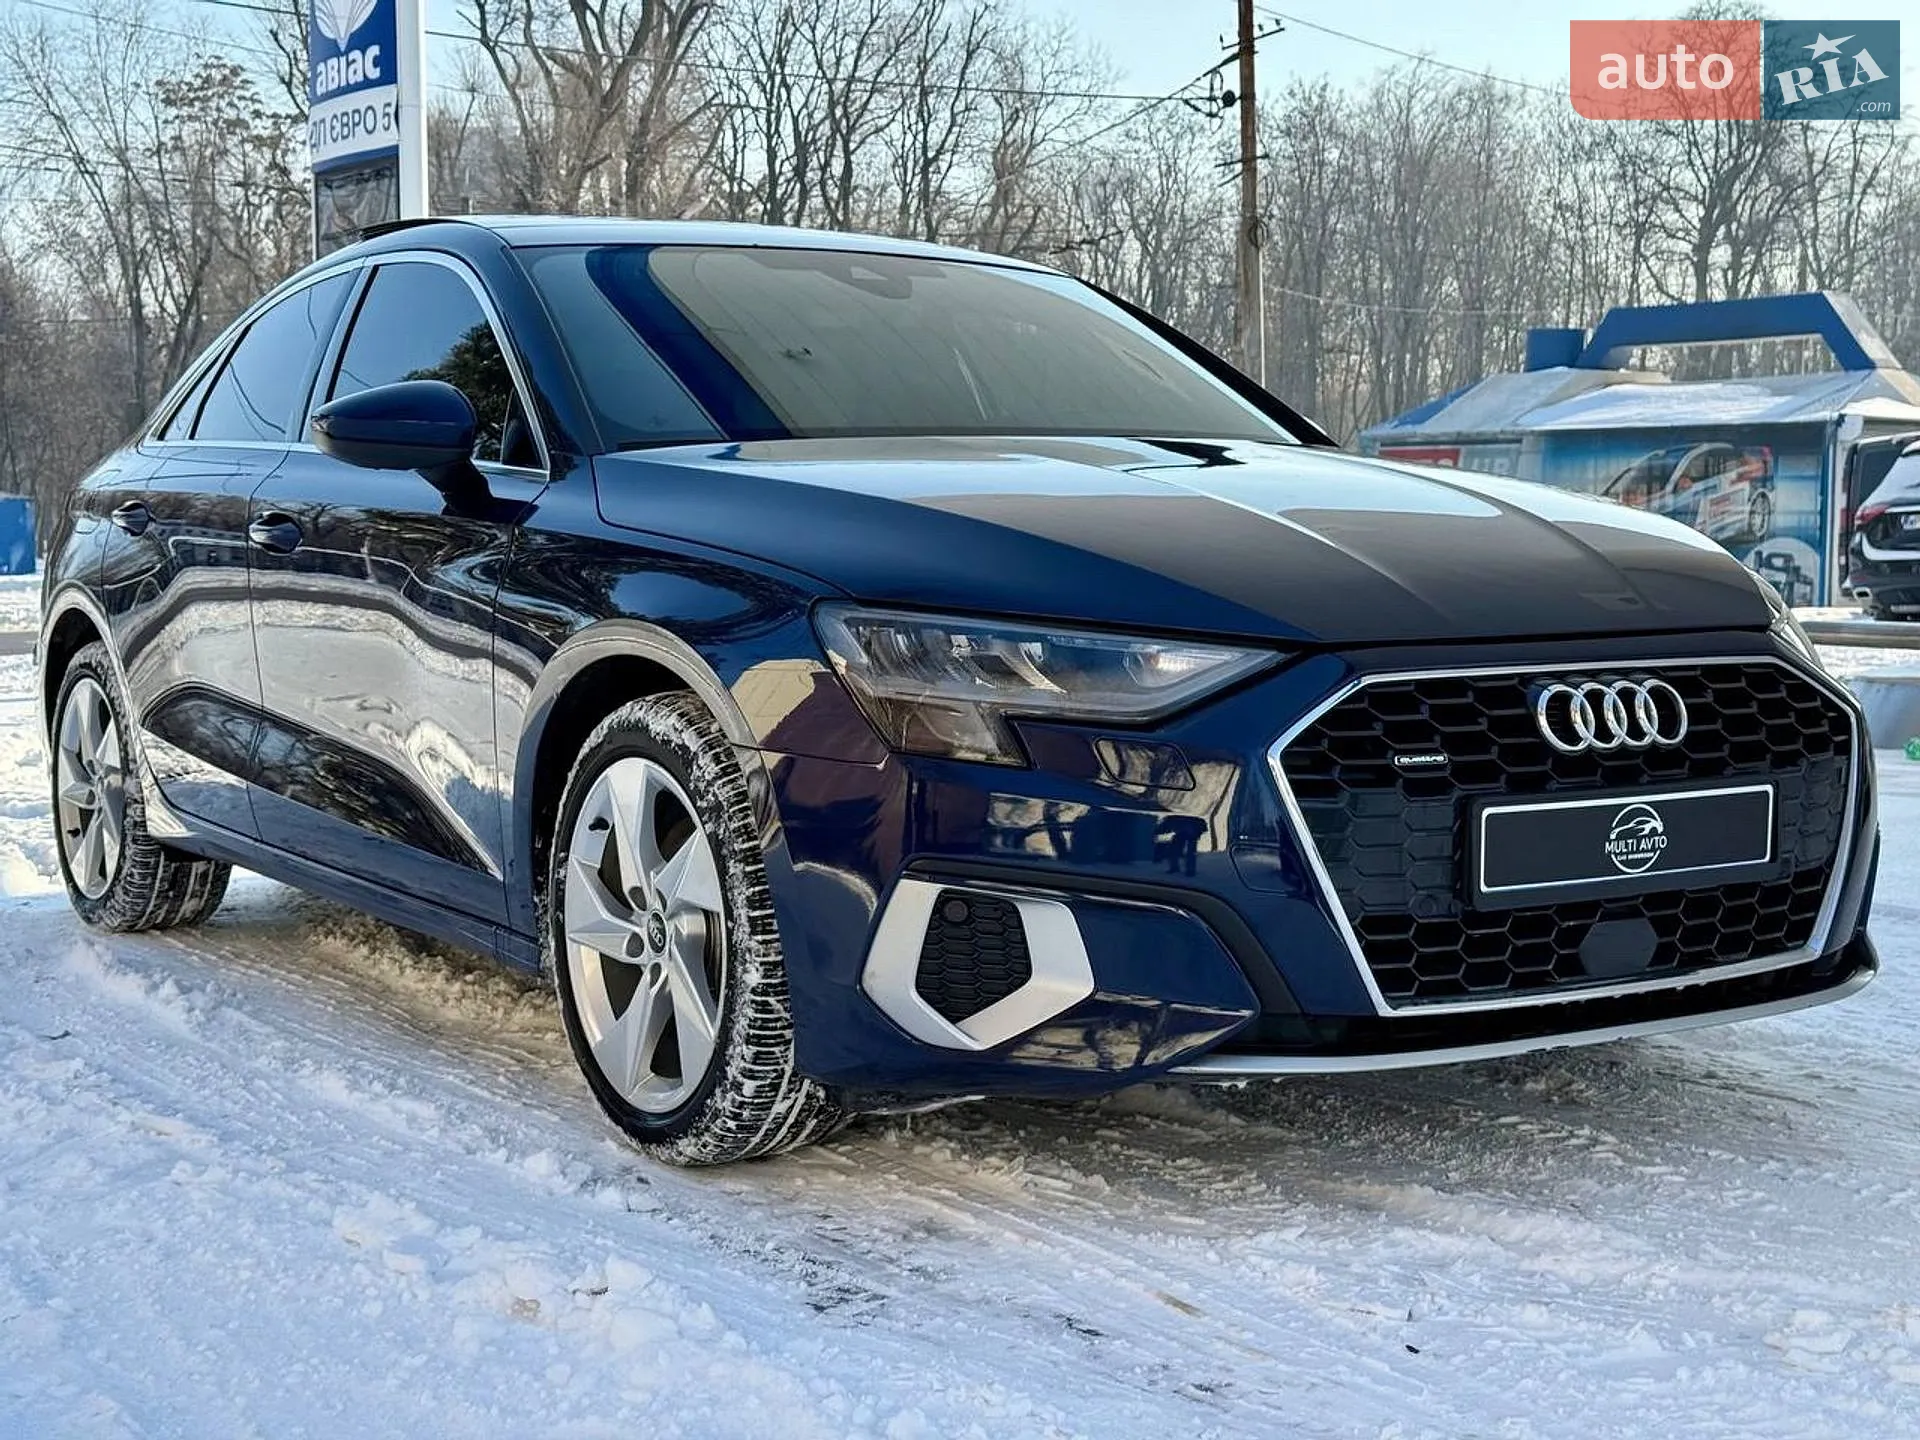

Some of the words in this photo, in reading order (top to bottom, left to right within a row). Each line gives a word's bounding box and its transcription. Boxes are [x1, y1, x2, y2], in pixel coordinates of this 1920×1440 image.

[330, 105, 377, 143] ЄВРО
[382, 102, 392, 131] 5
[1605, 838, 1637, 854] MULTI
[1639, 835, 1667, 849] AVTO
